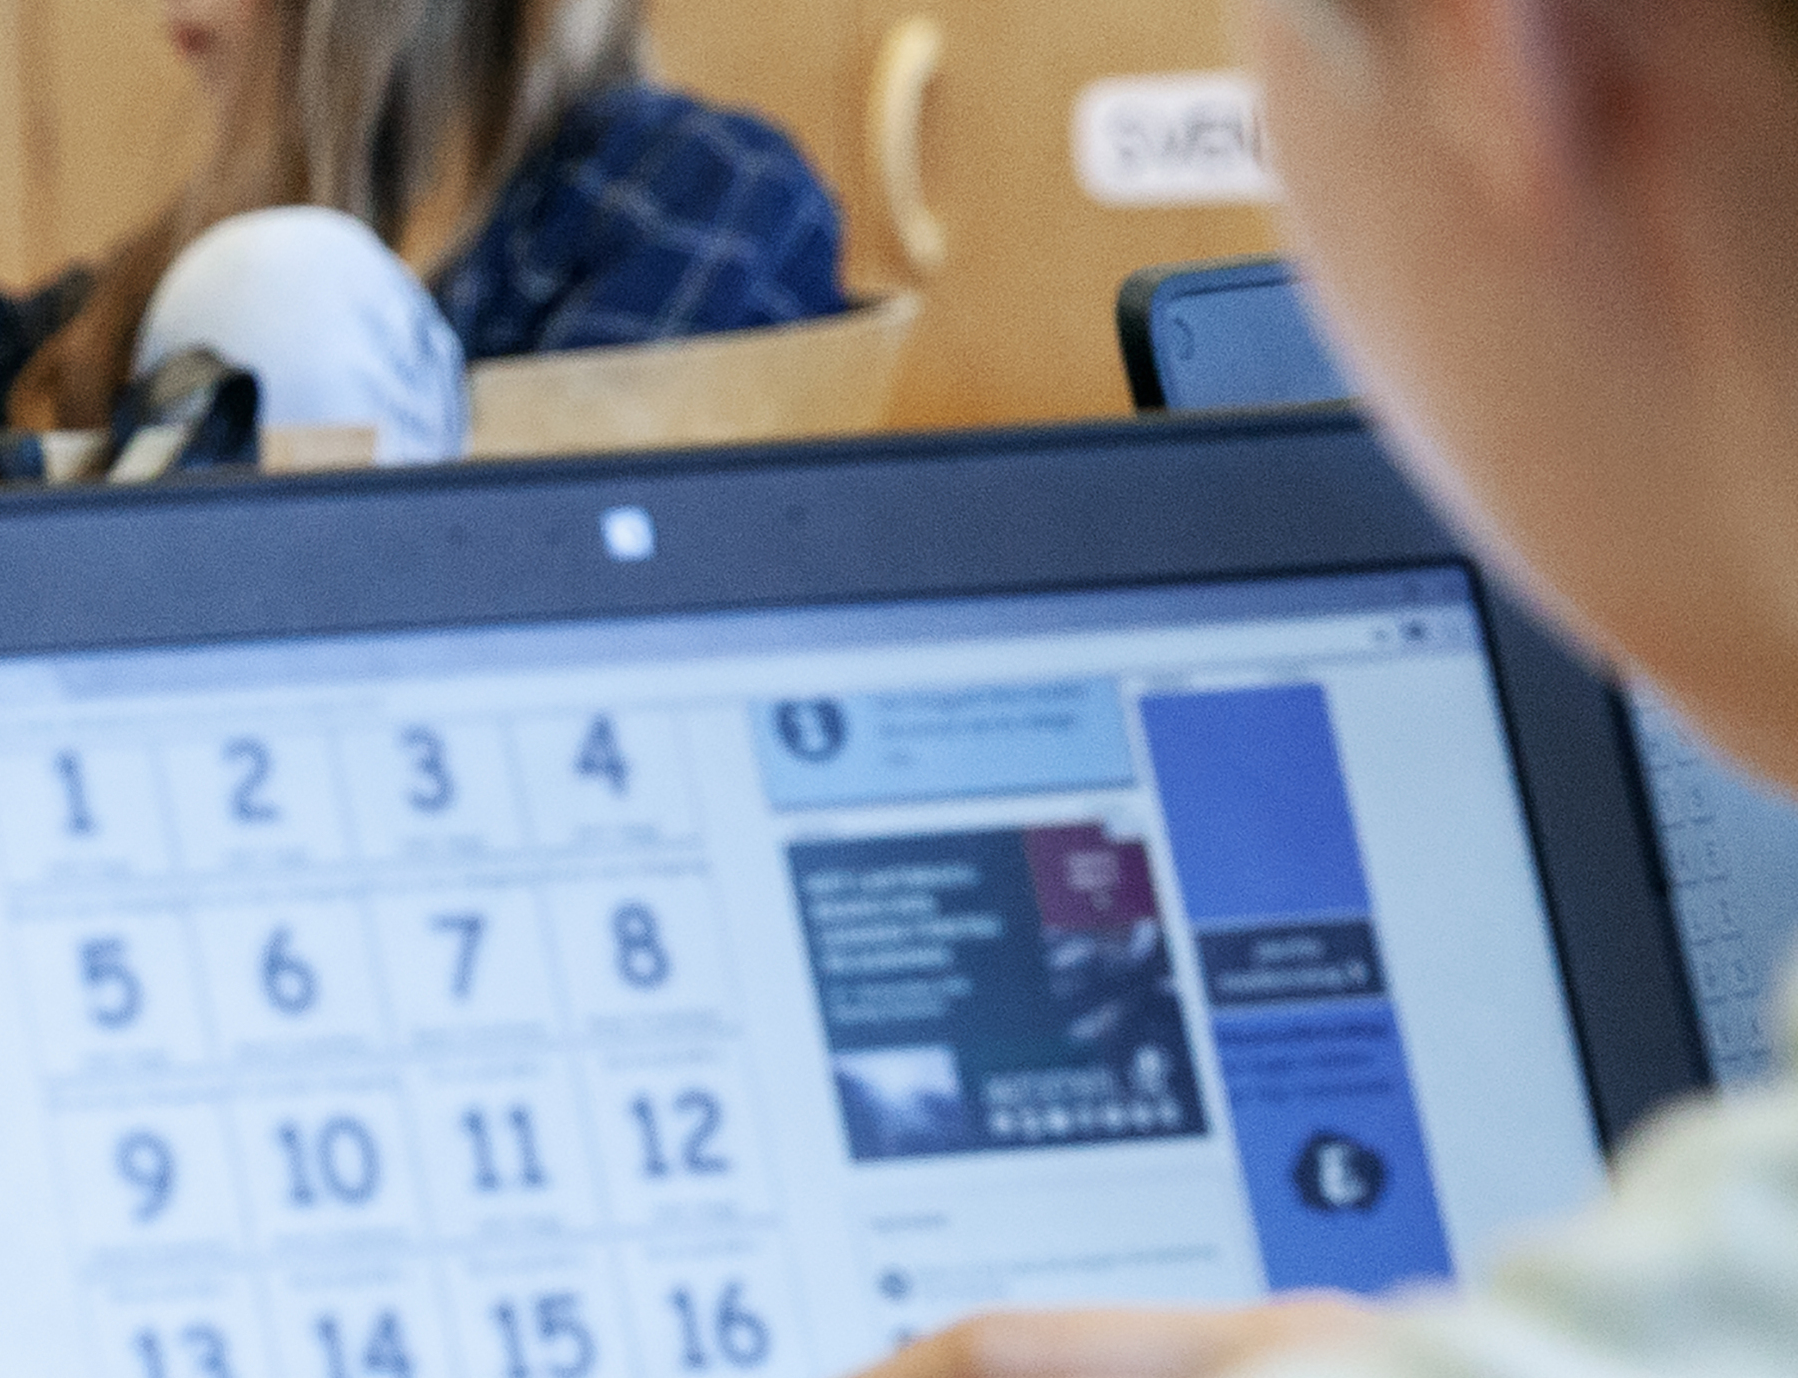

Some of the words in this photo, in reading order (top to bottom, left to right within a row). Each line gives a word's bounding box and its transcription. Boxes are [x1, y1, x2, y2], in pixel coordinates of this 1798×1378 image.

[52, 749, 100, 839] 1
[223, 736, 282, 827] 2
[401, 724, 457, 816] 3
[570, 711, 631, 796] 4
[77, 936, 144, 1031] 5
[257, 924, 320, 1018] 6
[430, 911, 488, 1000] 7
[609, 901, 672, 991] 8
[114, 1130, 179, 1224] 9
[274, 1115, 382, 1209] 10
[460, 1103, 550, 1195] 11
[627, 1087, 731, 1181] 12
[667, 1281, 772, 1373] 16
